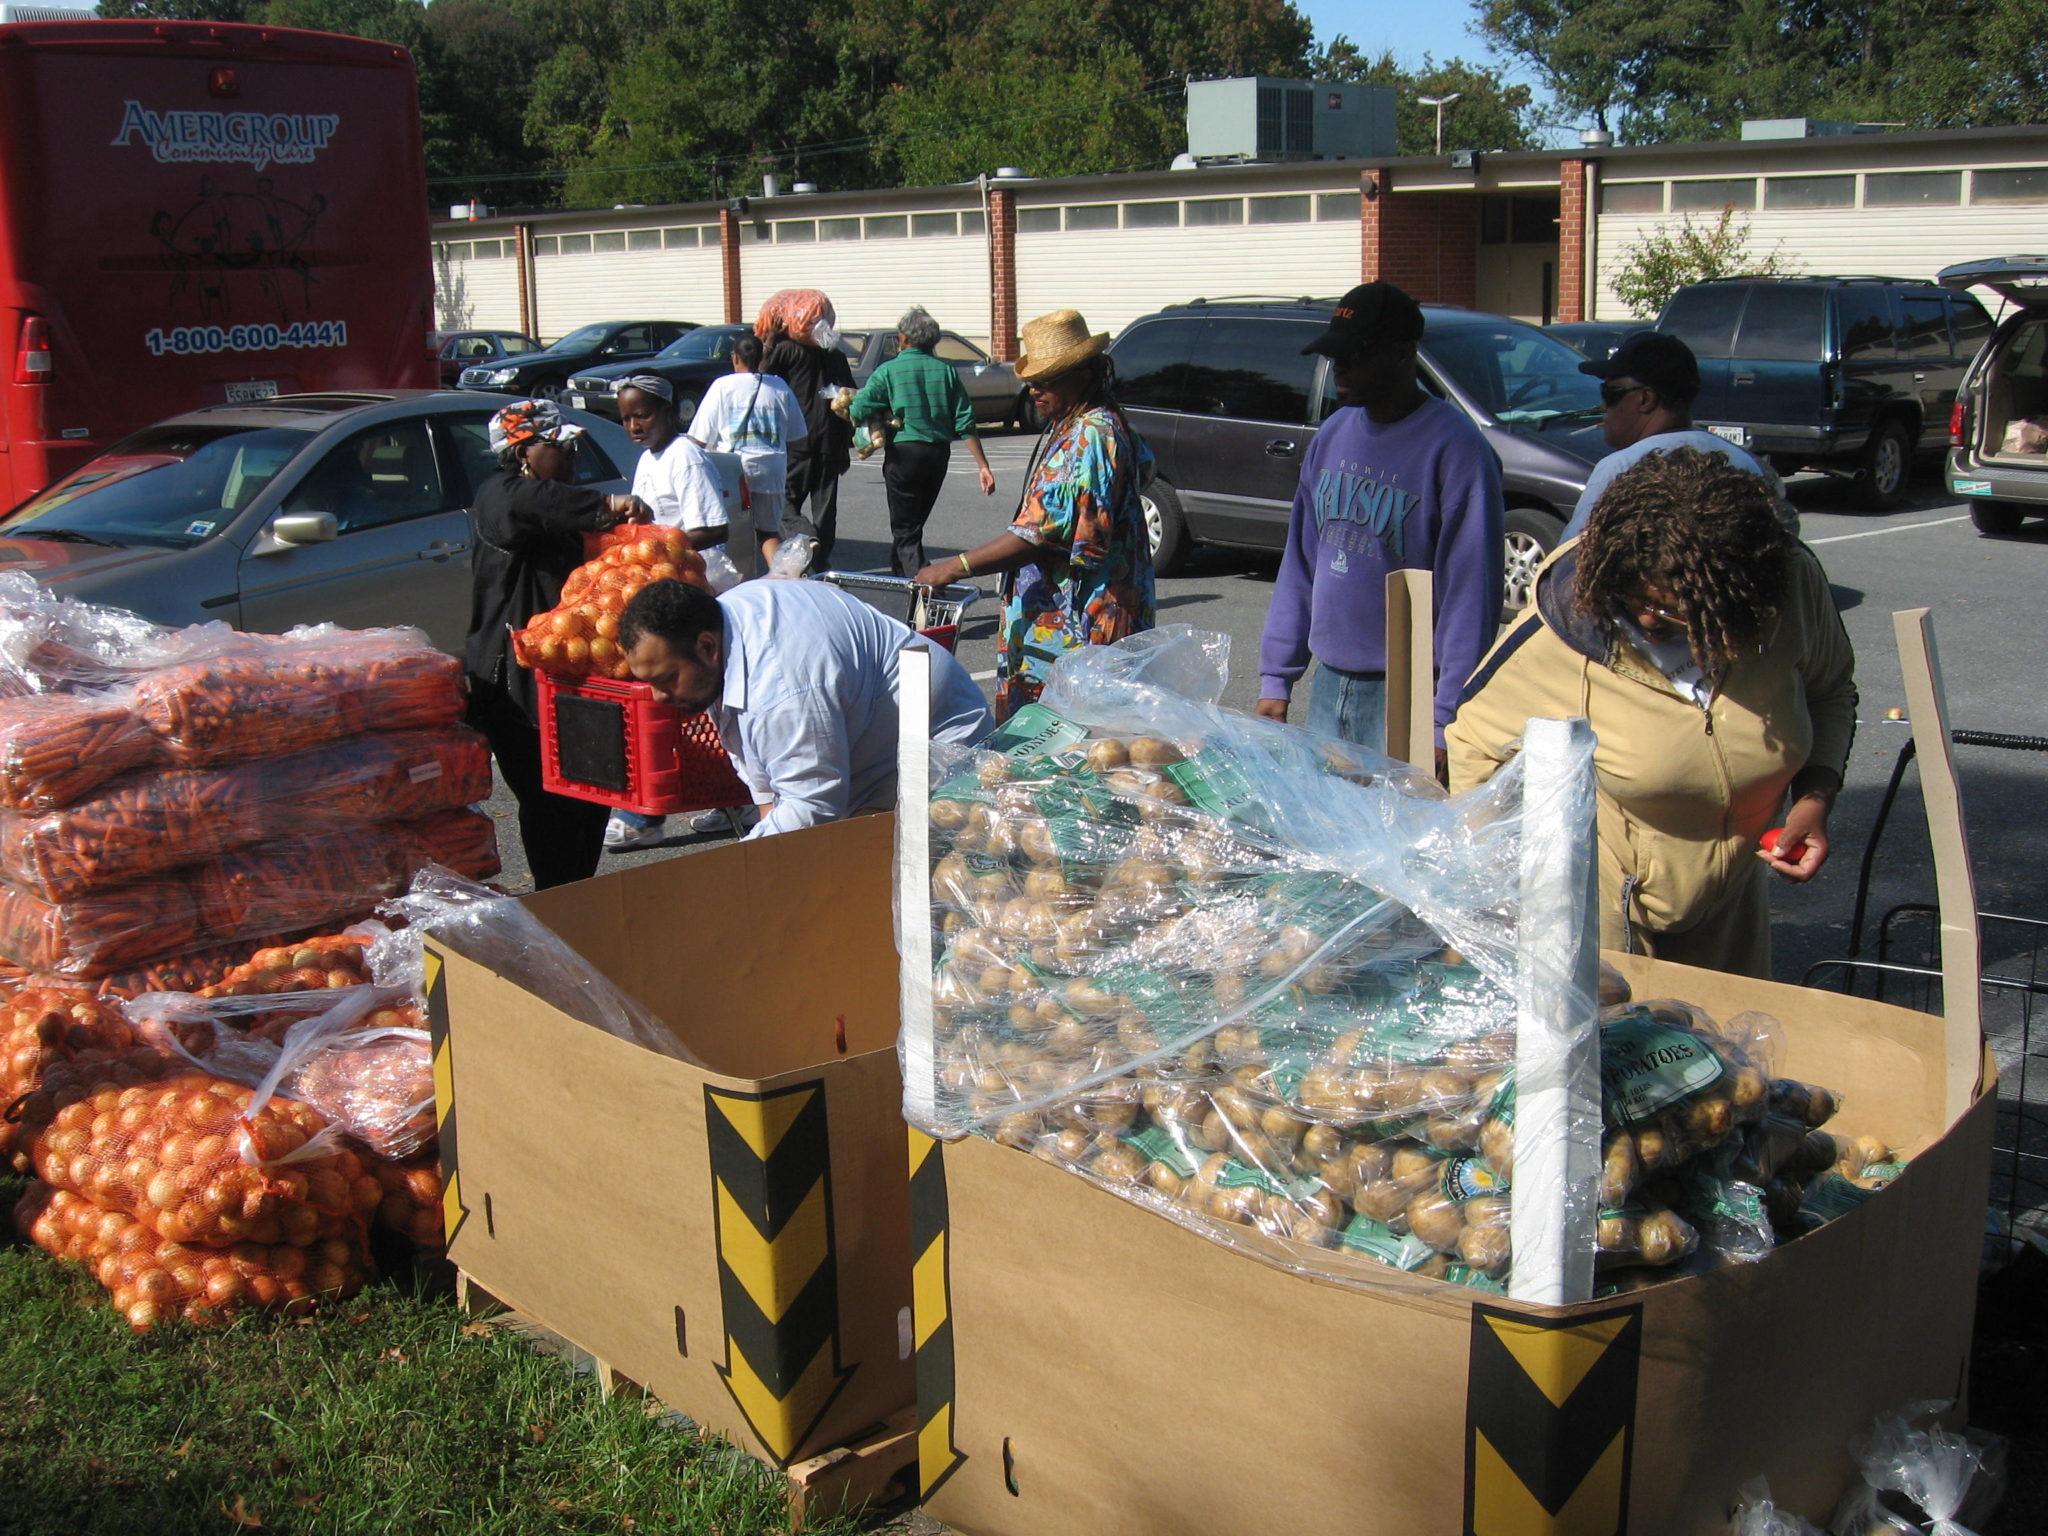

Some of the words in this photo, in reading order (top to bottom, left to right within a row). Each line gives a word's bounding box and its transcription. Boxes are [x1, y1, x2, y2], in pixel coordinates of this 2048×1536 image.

[155, 140, 270, 171] Community
[272, 142, 314, 161] Care
[146, 321, 347, 354] 1-800-600-4441
